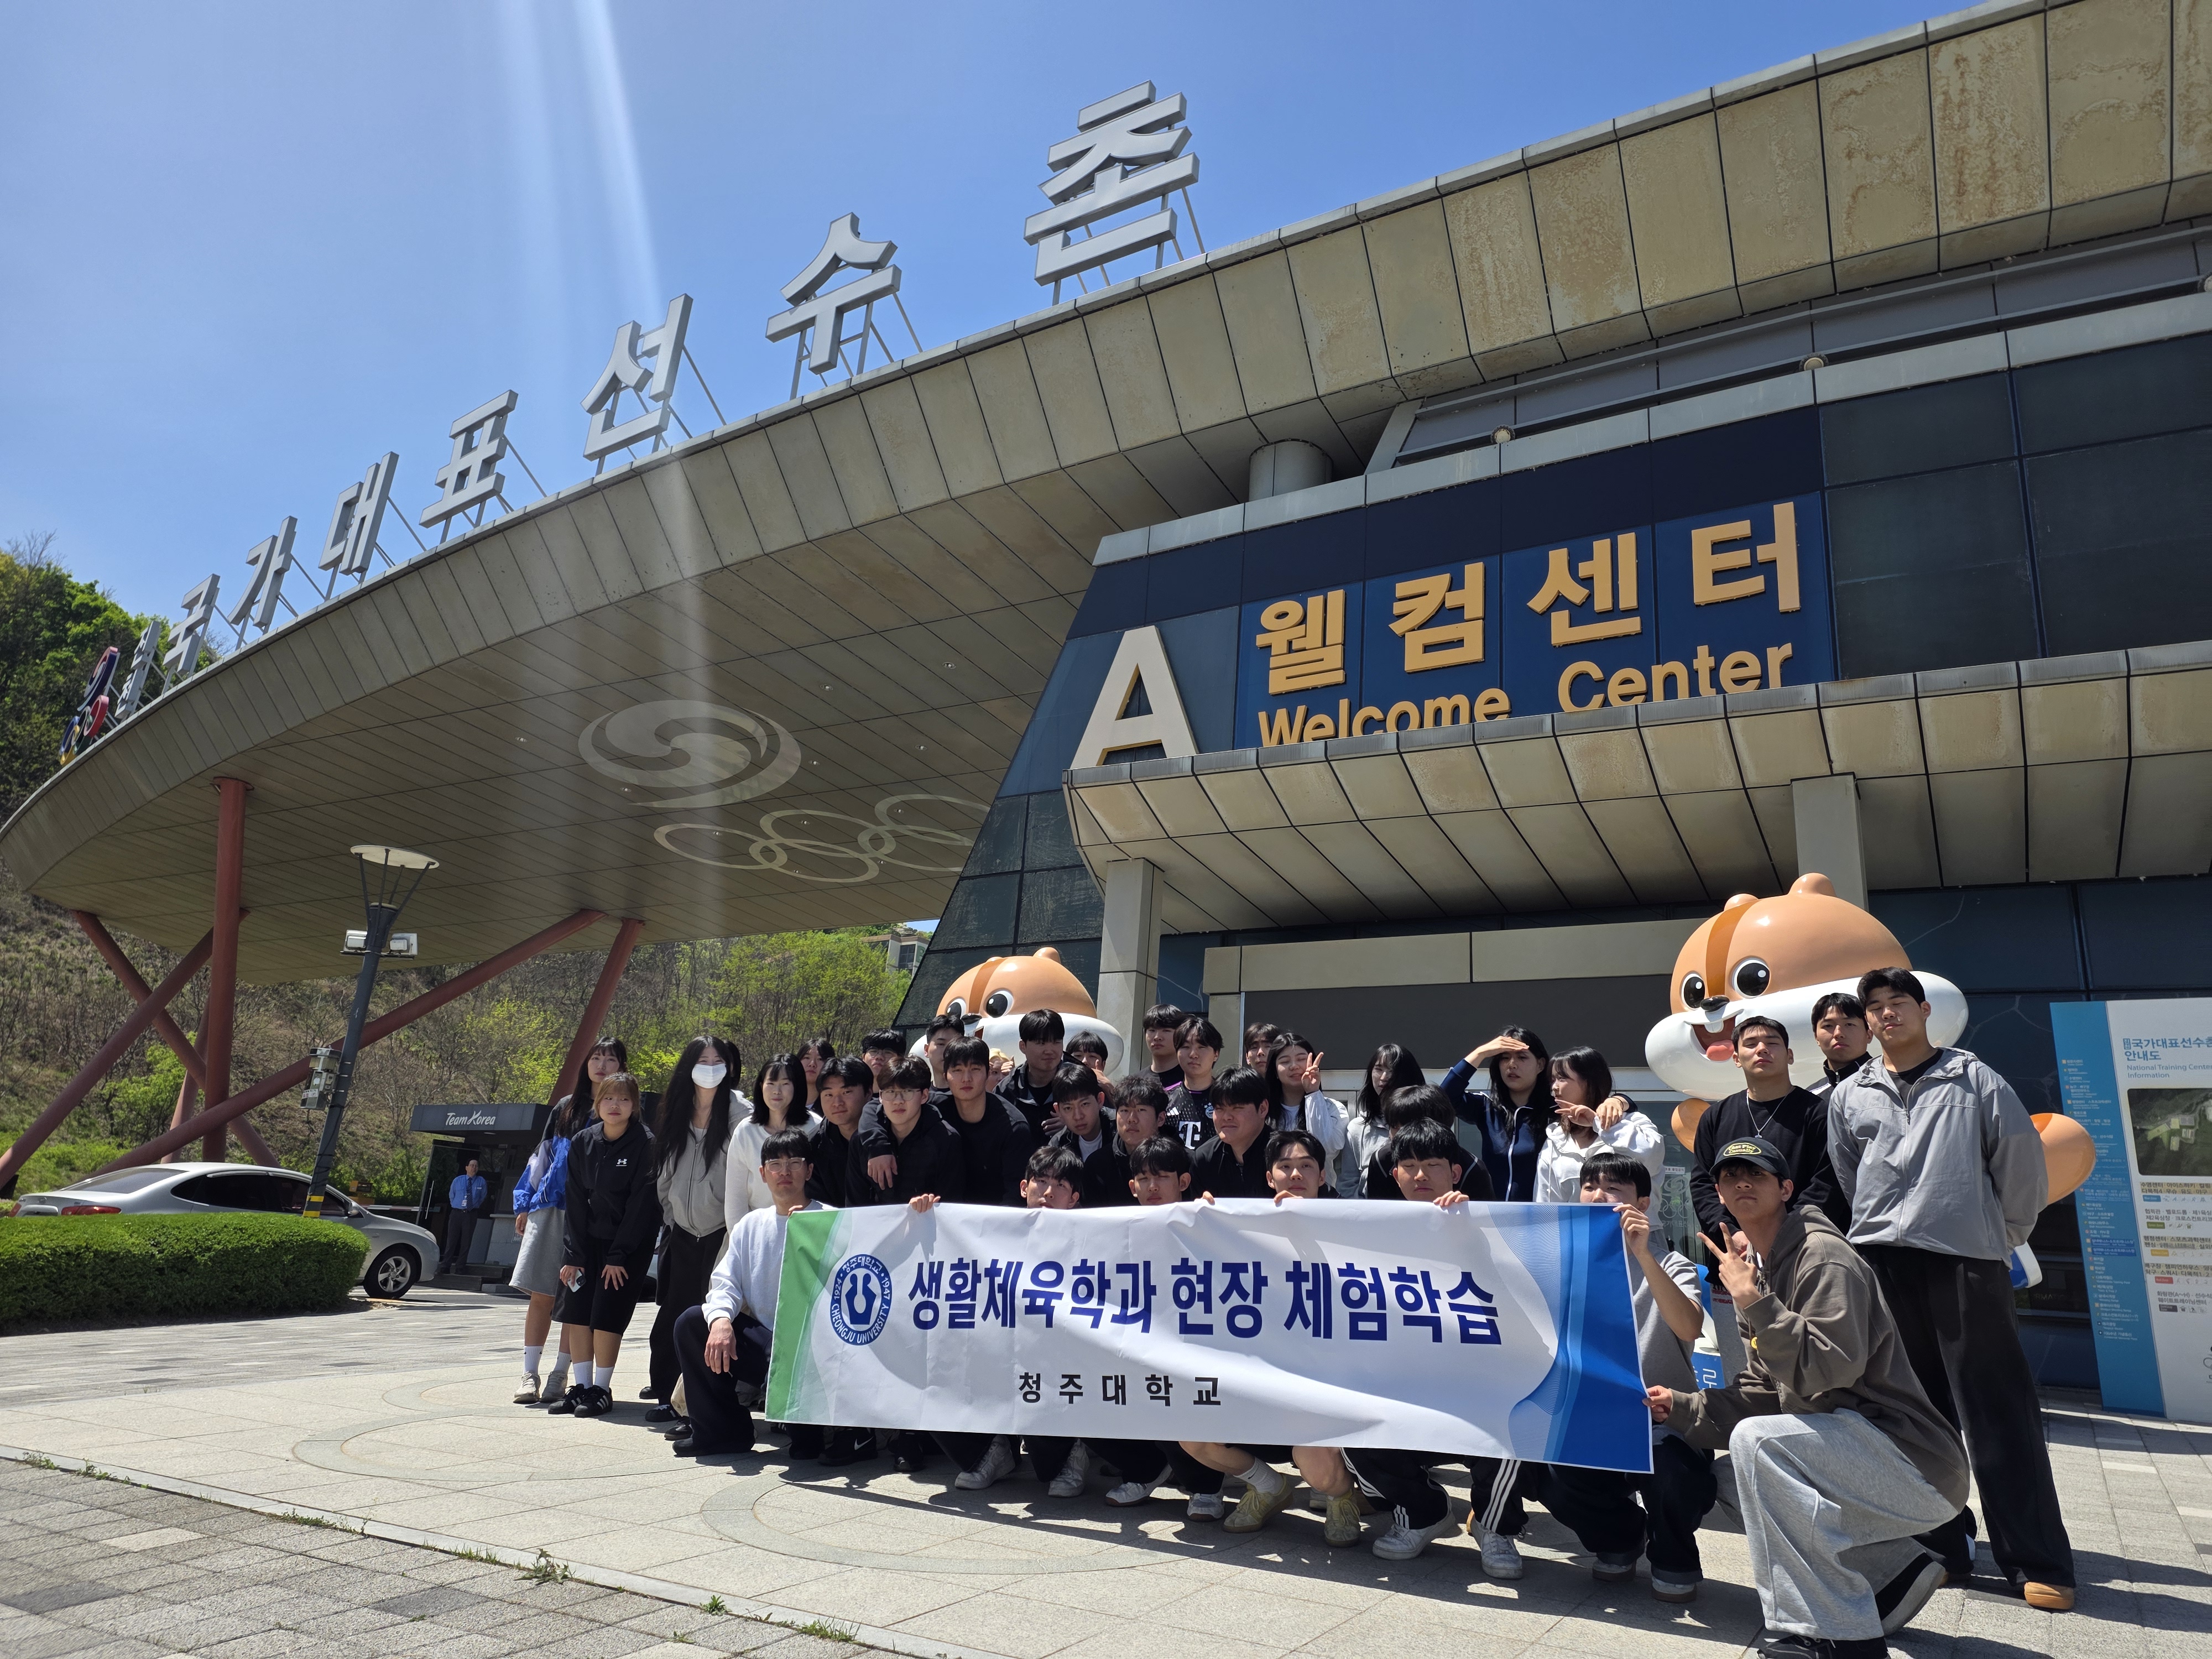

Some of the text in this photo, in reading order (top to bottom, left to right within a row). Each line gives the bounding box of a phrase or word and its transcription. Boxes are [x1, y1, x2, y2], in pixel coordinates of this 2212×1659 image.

[1256, 502, 1801, 695] 웰컴센터
[1069, 625, 1198, 769] A
[1258, 643, 1793, 747] Welcome Center
[2125, 1050, 2162, 1061] 안내도
[446, 1110, 496, 1126] Team Korea
[842, 1256, 883, 1274] 청주대학교
[834, 1278, 842, 1300] 1924
[881, 1277, 890, 1300] 1947
[908, 1258, 1502, 1345] 생활체육학과 현장 체험학습
[832, 1303, 889, 1344] CHEONGJU UNIVERSITY
[1019, 1372, 1222, 1407] 청주대학교
